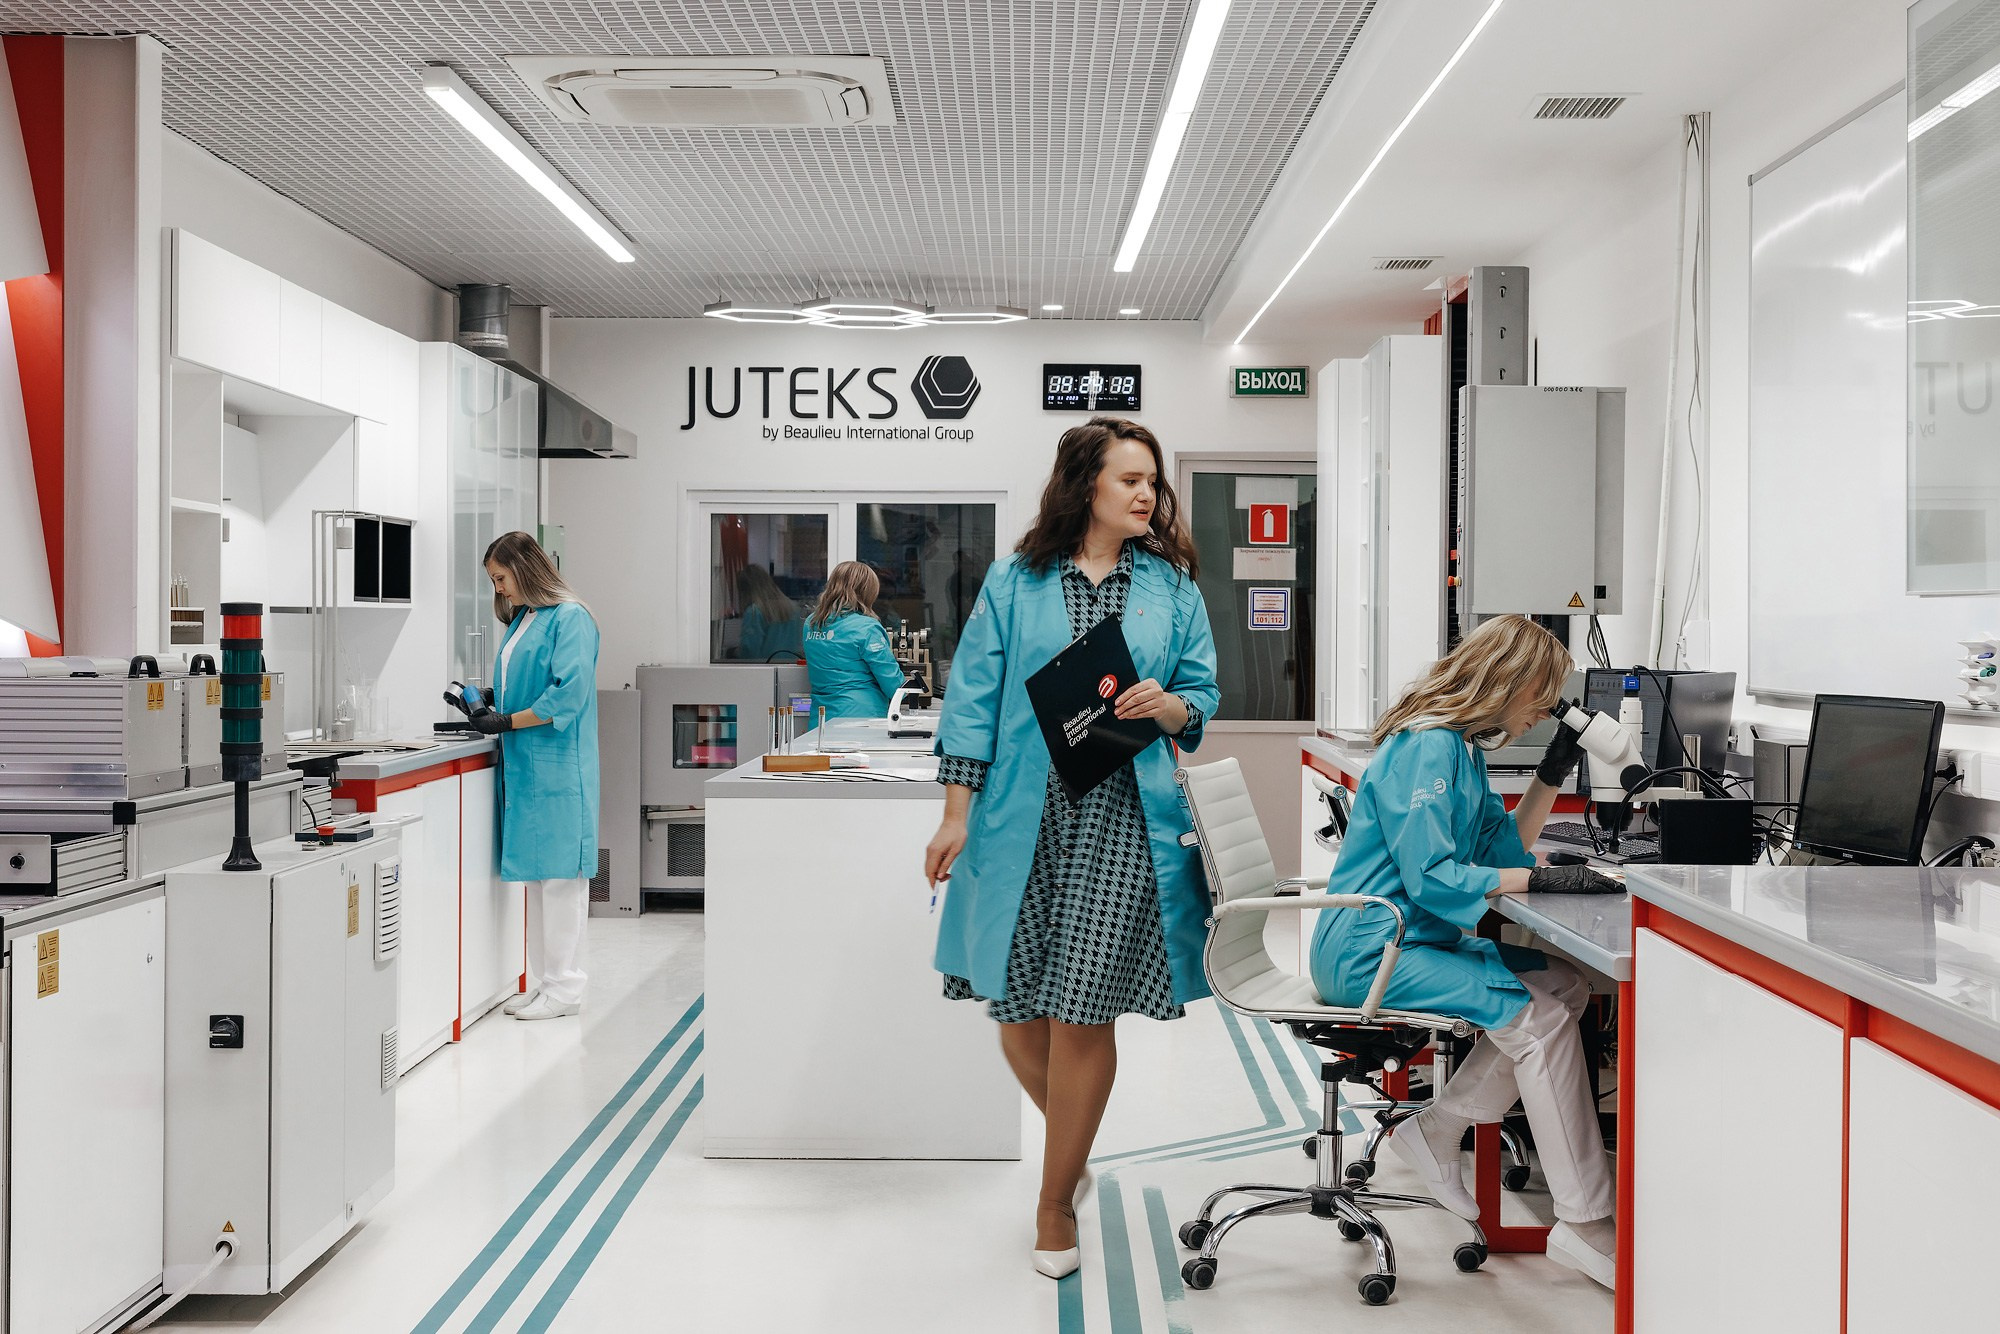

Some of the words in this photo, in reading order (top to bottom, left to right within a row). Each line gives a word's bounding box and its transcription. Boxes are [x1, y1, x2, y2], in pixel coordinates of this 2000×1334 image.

[1239, 371, 1302, 392] ВЫХОД
[680, 366, 899, 431] JUTEKS
[762, 424, 779, 441] by
[784, 424, 841, 440] Beaulieu
[847, 424, 930, 440] International
[935, 425, 974, 442] Group
[1271, 616, 1283, 624] 112
[1063, 706, 1091, 731] Beaulieu
[1066, 703, 1106, 739] International
[1069, 729, 1088, 746] Group
